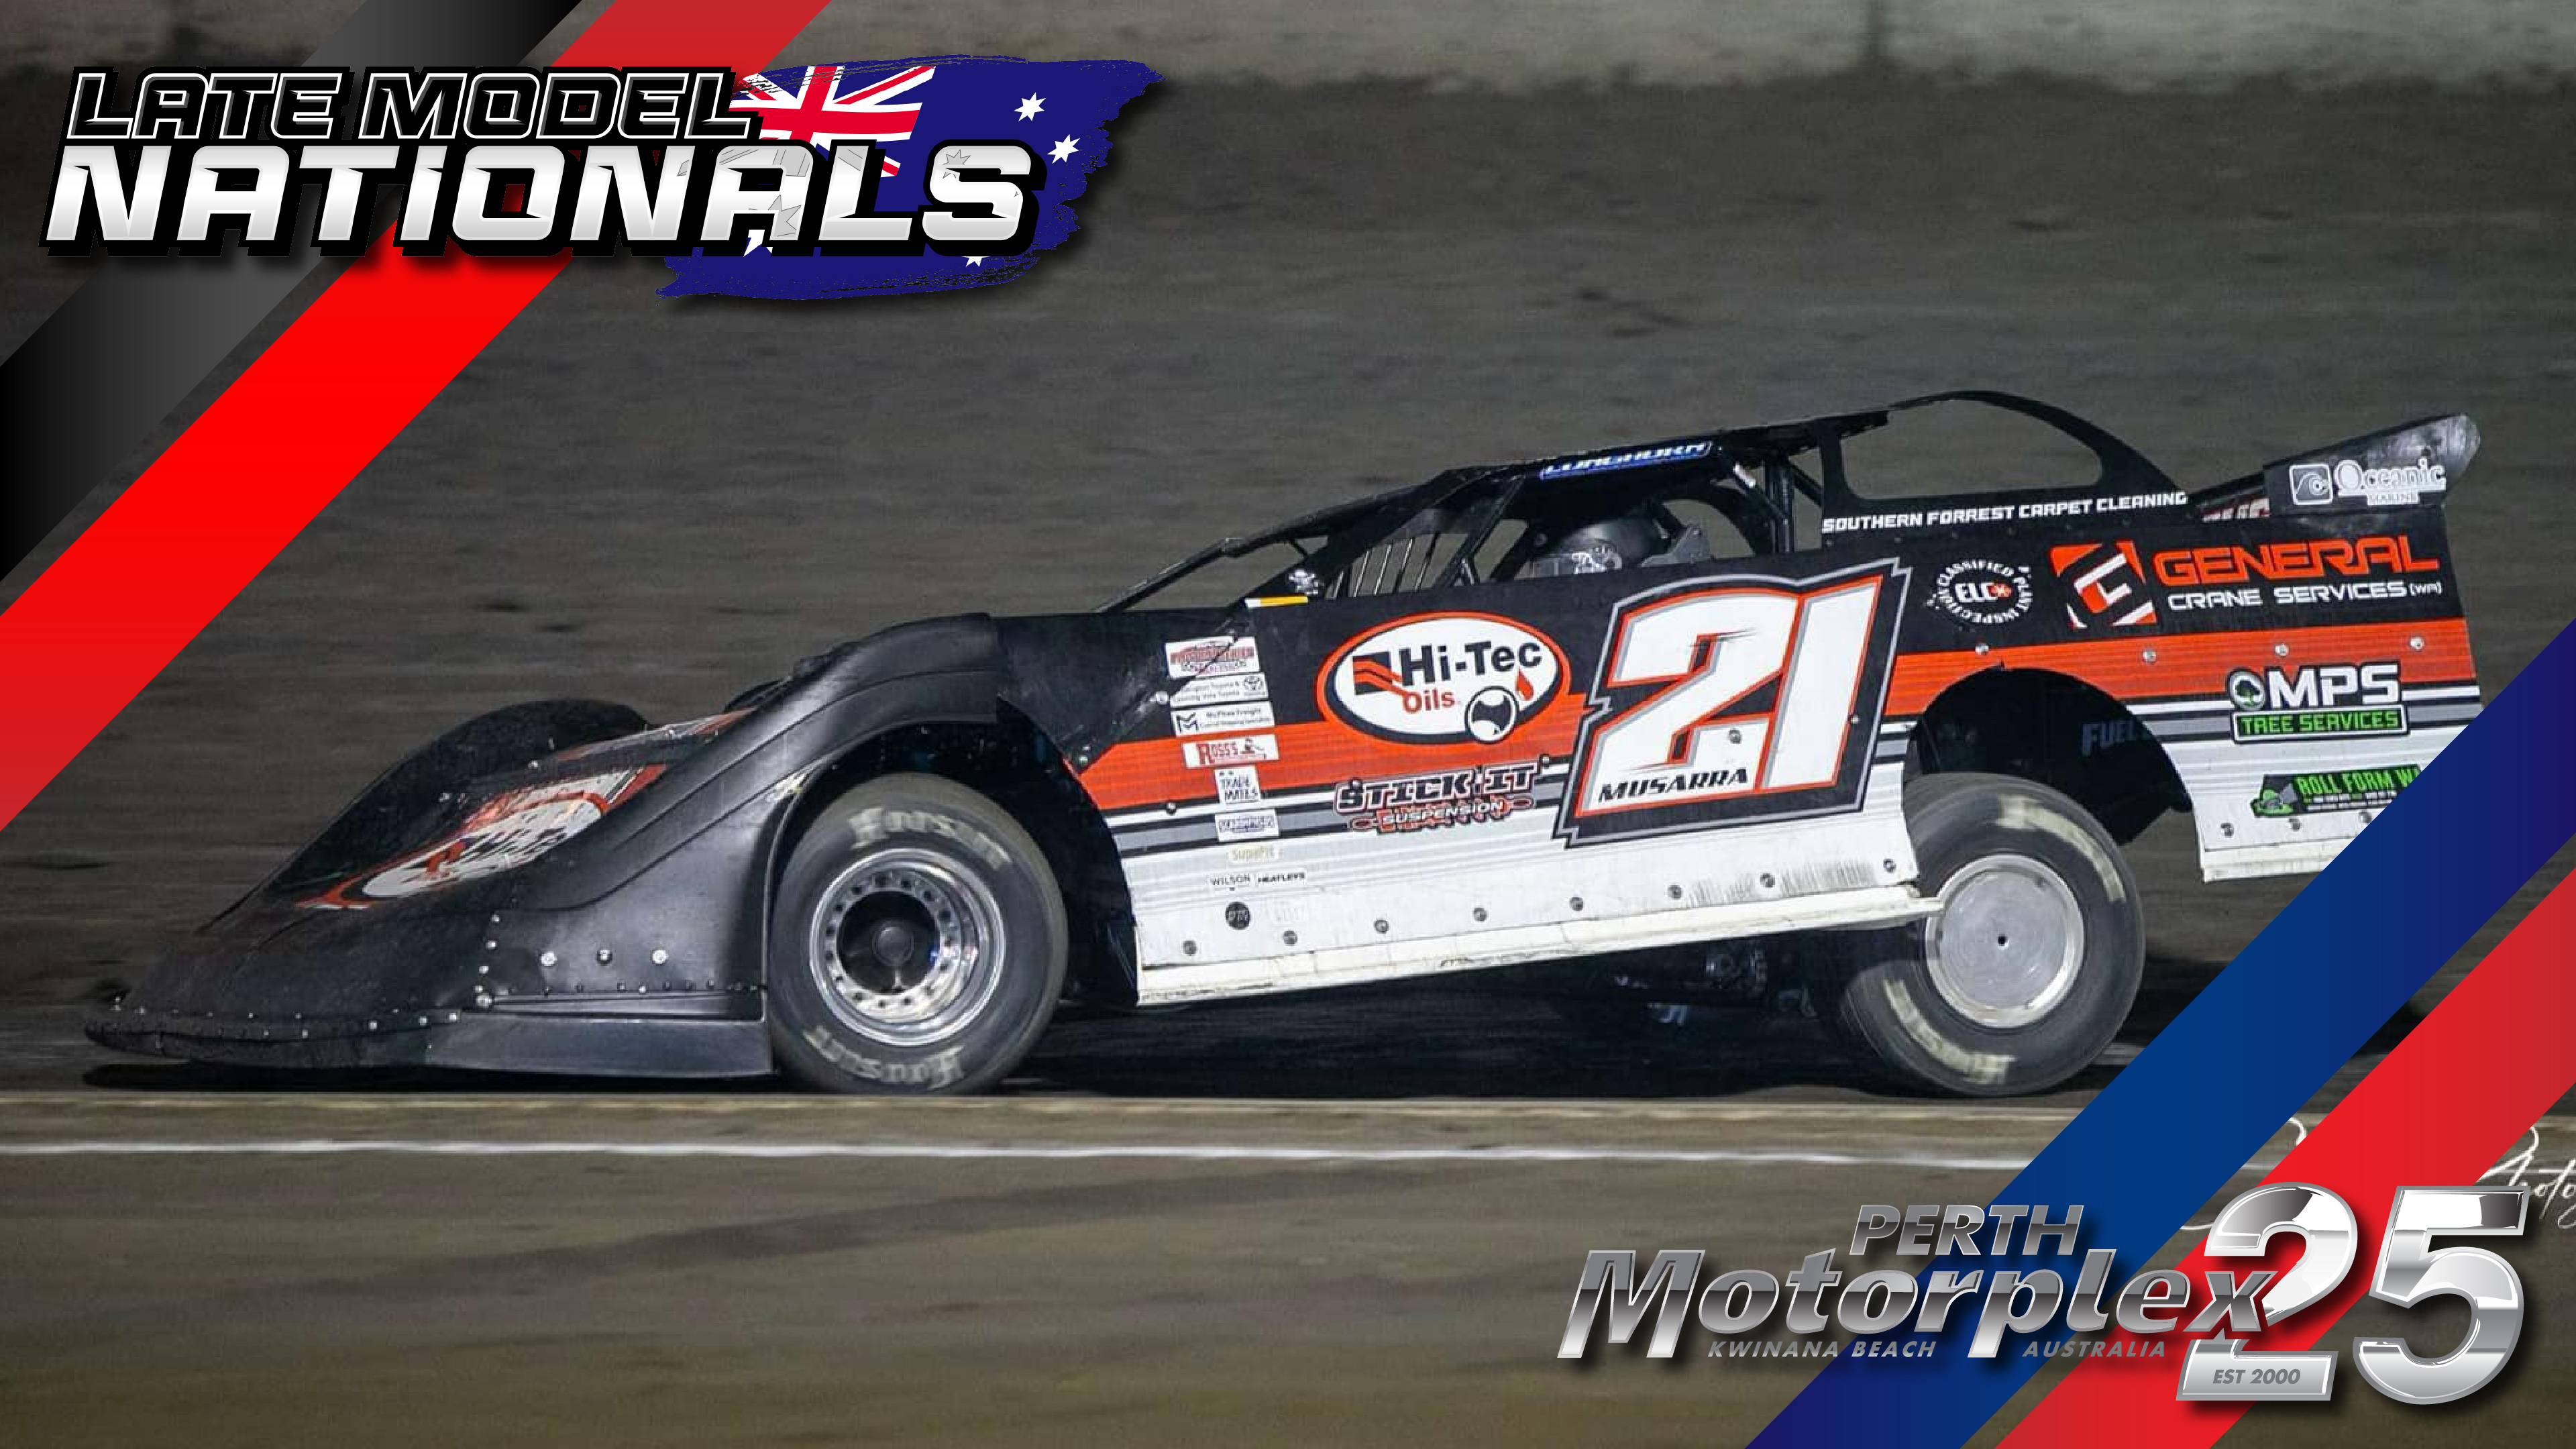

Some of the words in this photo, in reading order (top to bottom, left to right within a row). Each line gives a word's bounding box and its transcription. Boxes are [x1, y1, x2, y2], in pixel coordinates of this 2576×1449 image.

[2334, 458, 2446, 495] Oceanic
[1821, 512, 1923, 534] SOUTHERN
[1927, 506, 2015, 526] FORREST
[2018, 499, 2092, 519] CARPET
[2096, 492, 2189, 512] CLEANING
[2152, 535, 2440, 587] GENERAL
[2167, 588, 2263, 610] CRANE
[2273, 581, 2407, 604] SERVICES
[1399, 640, 1542, 687] Hi-Tec
[1403, 690, 1456, 713] Oils
[1574, 576, 1883, 817] 21
[2268, 663, 2400, 709] MPS
[2241, 714, 2296, 735] TREE
[2300, 710, 2399, 732] SERVICES
[1599, 767, 1749, 802] MUSARRA
[2297, 774, 2343, 796] ROLL
[2341, 770, 2396, 793] FORM
[1379, 797, 1507, 828] SUSPENSION
[1210, 873, 1251, 885] WILSON
